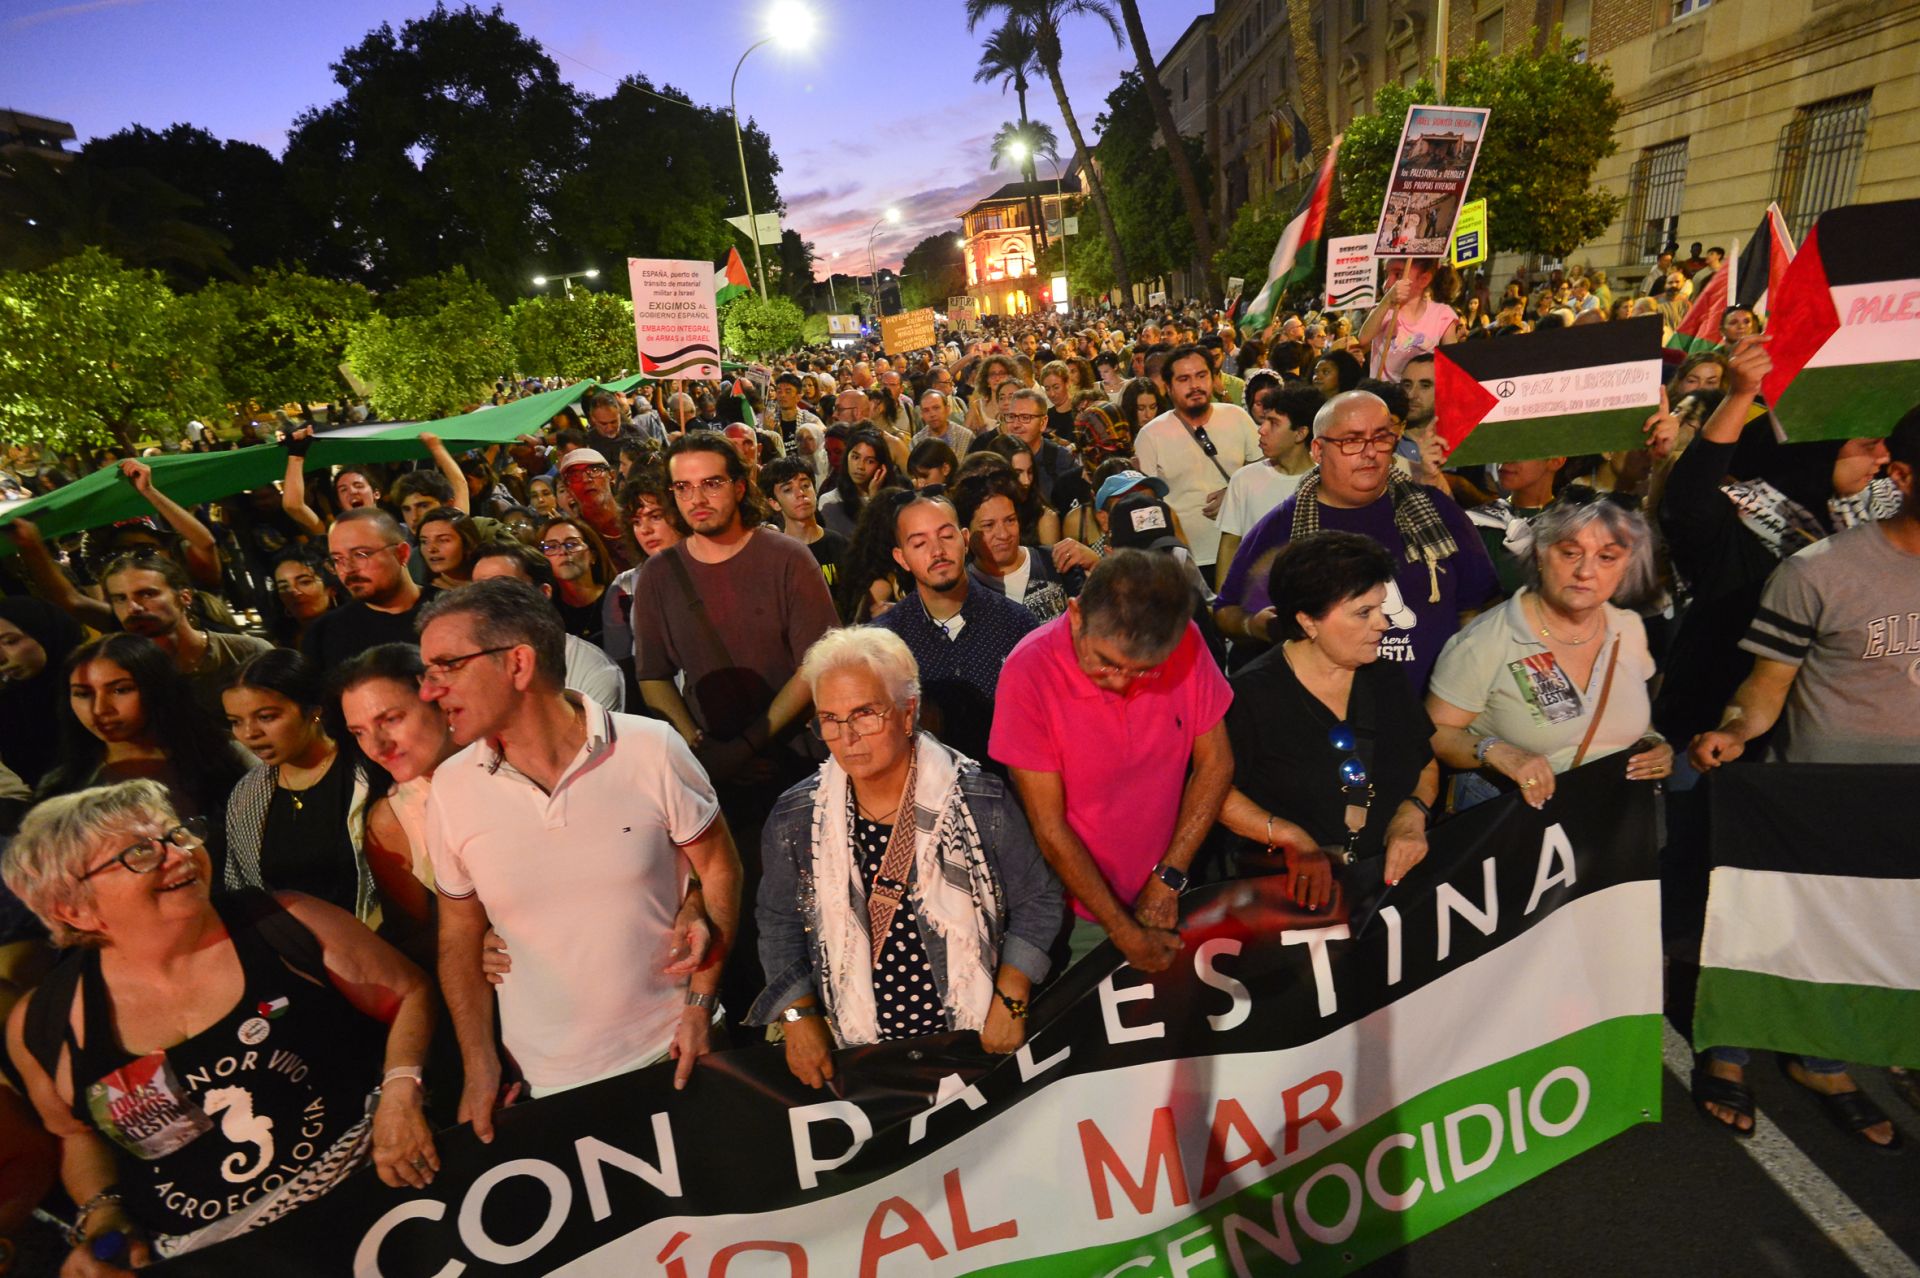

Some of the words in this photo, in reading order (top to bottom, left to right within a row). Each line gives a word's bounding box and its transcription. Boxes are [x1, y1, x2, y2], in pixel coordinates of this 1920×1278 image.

[1410, 168, 1438, 179] PALESTINOS
[1403, 181, 1412, 190] SUS
[1413, 181, 1434, 190] PROPIAS
[1339, 245, 1368, 253] DERECHO
[1336, 256, 1369, 265] RETORNO
[642, 270, 668, 279] ESPAÑA,
[670, 271, 690, 279] puerto
[691, 270, 699, 278] de
[648, 302, 697, 311] EXIGIMOS
[1846, 291, 1920, 327] PALE
[677, 311, 709, 319] ESPAÑOL
[1520, 378, 1554, 398] PAZ
[1560, 376, 1572, 393] Y
[1574, 367, 1650, 392] LIBERTAD:
[1503, 405, 1520, 417] UN
[1585, 398, 1600, 409] UN
[1381, 633, 1411, 645] será
[1376, 645, 1416, 662] ISTA
[353, 1111, 683, 1278] CON
[788, 823, 1577, 1190] PALESTINA
[186, 1051, 258, 1092] NOR
[267, 1050, 309, 1083] VIVO
[859, 1168, 1019, 1278] AL
[1077, 1070, 1344, 1221] MAR
